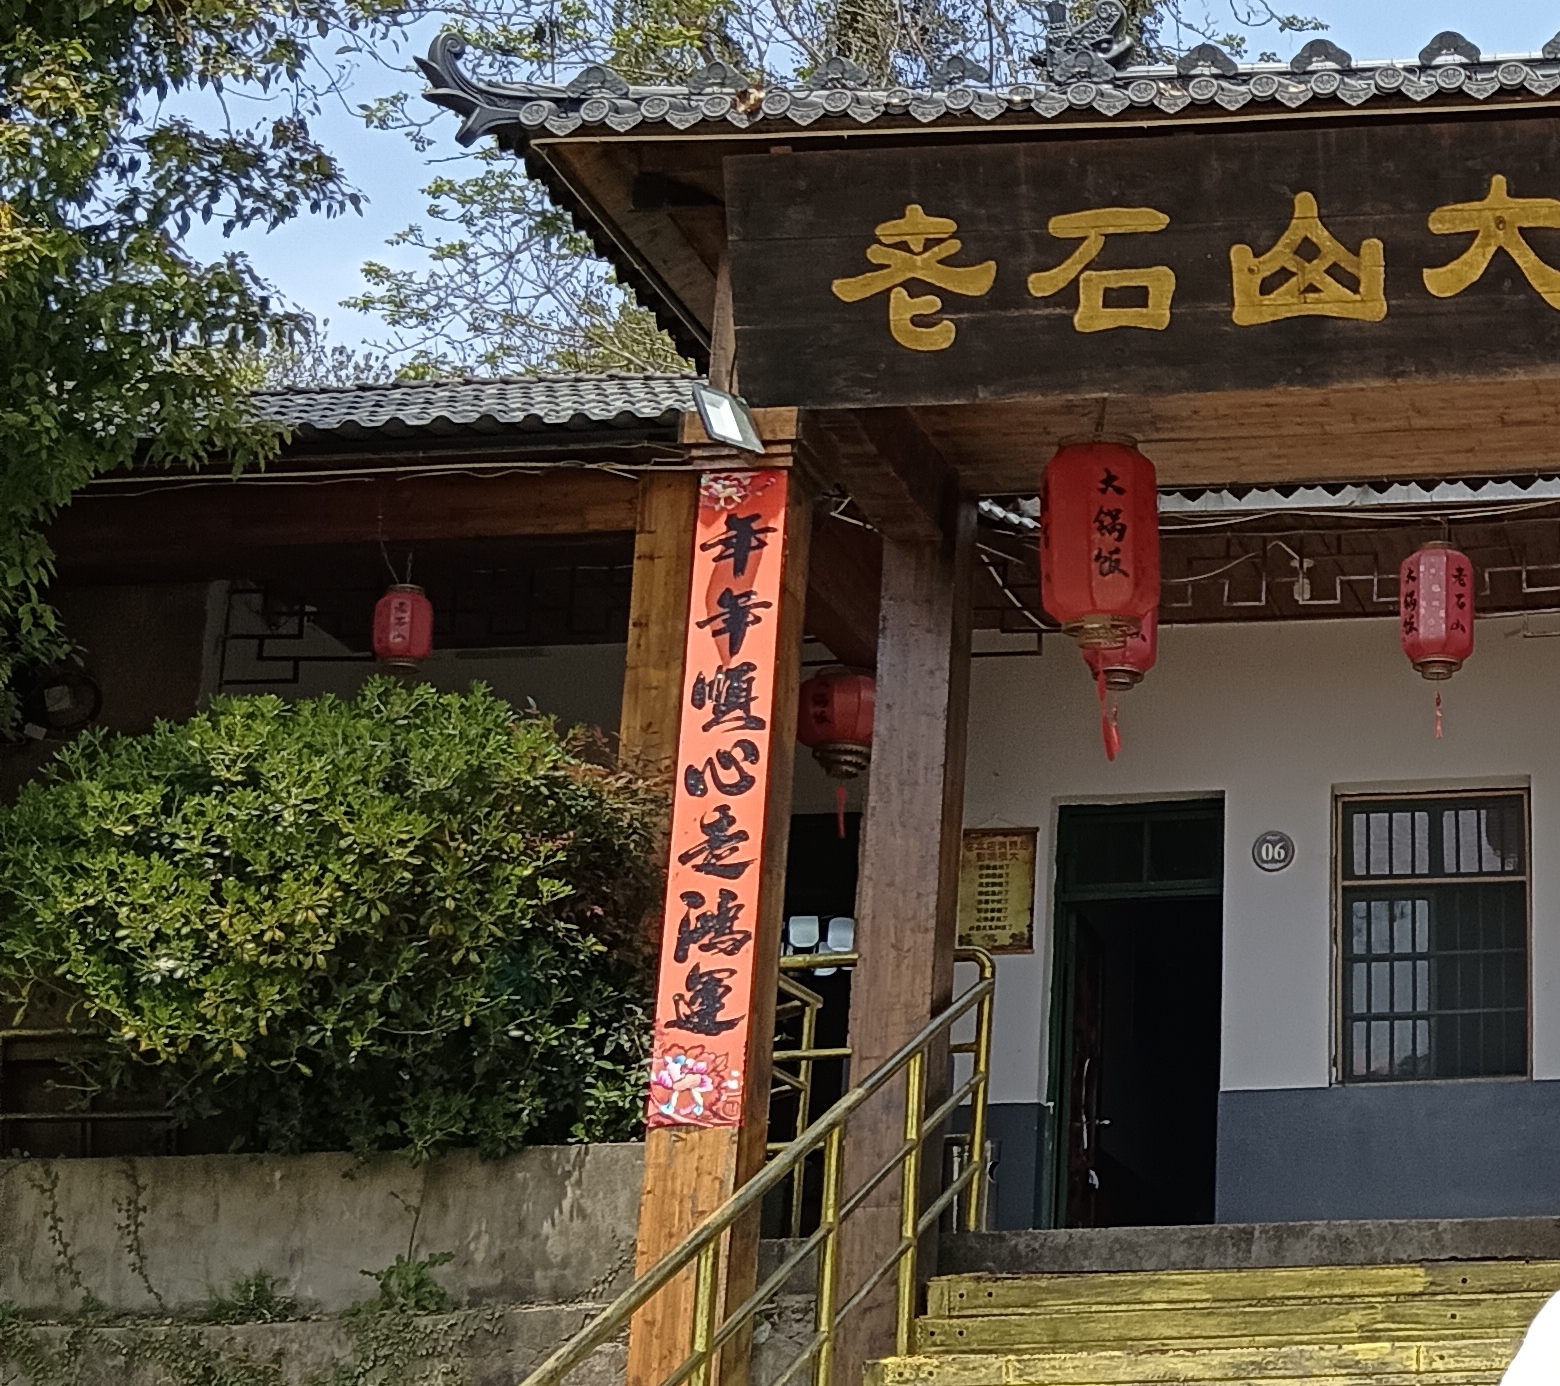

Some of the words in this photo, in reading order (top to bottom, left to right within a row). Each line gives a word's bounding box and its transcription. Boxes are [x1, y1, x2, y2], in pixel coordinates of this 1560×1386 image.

[1093, 468, 1129, 578] 大锅饭
[1261, 841, 1286, 861] 06
